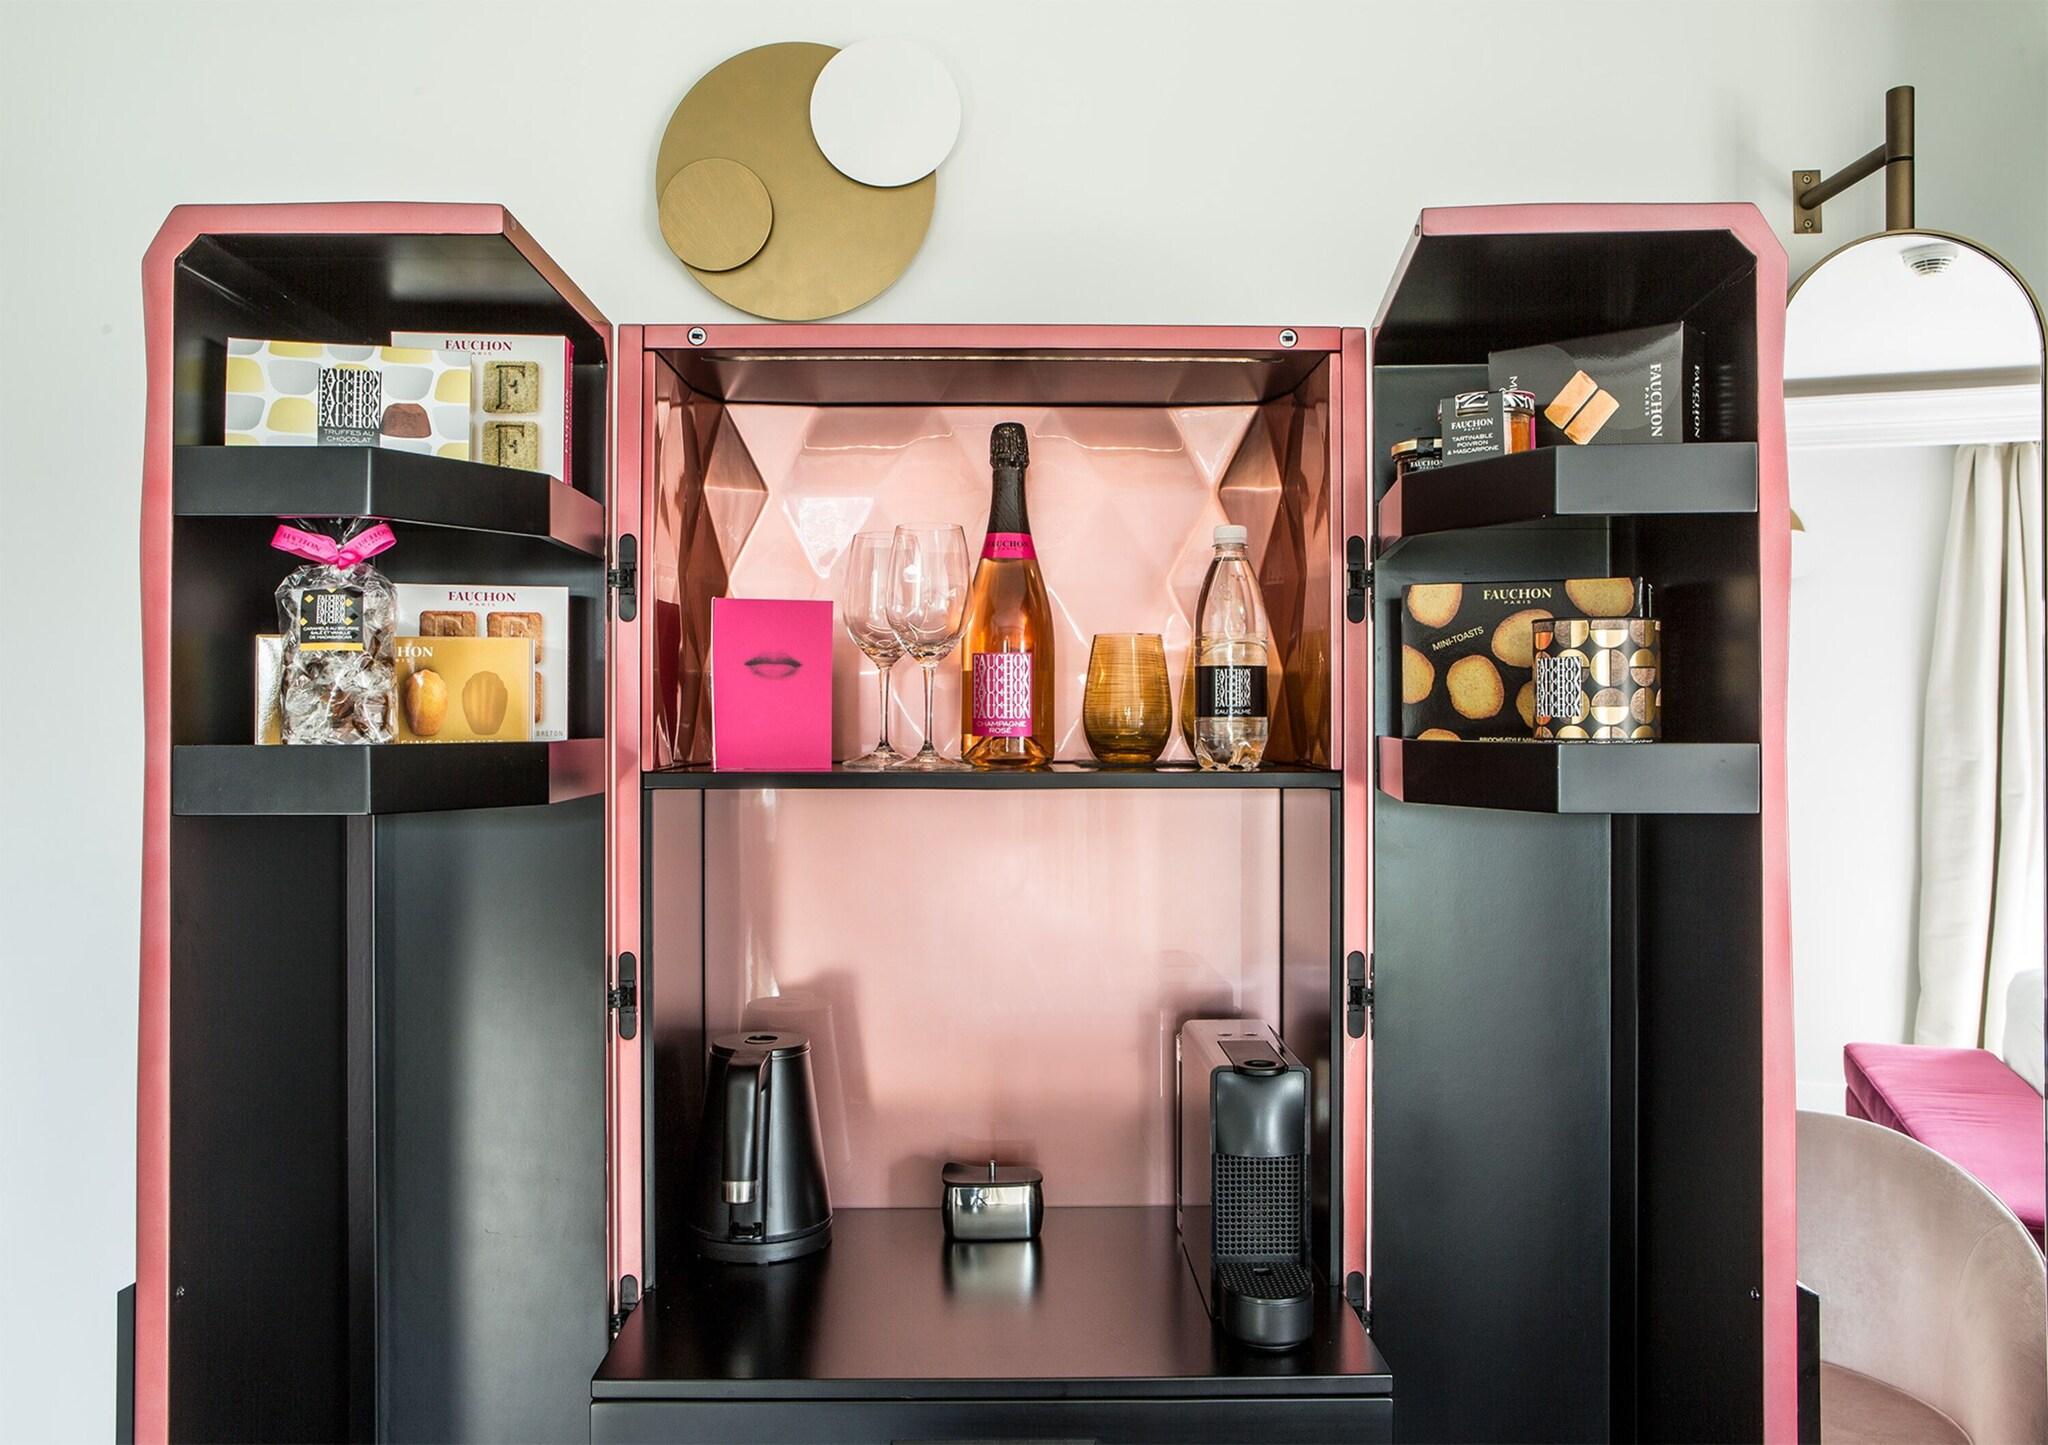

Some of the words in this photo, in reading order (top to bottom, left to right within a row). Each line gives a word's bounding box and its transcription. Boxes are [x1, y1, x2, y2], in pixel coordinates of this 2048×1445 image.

[445, 340, 513, 350] FAUCHON
[319, 368, 382, 382] FAUCHON
[1650, 363, 1663, 437] FAUCHON
[318, 414, 380, 429] FAUCHON
[1451, 418, 1494, 430] FAUCHON
[1452, 432, 1493, 442] TARTINABLE
[1453, 445, 1499, 454] MASCARPONE
[1456, 440, 1488, 448] POIVRON
[448, 592, 516, 602] FAUCHON
[1483, 588, 1552, 600] FAUCHON
[1432, 626, 1485, 651] MINI-TOASTS
[973, 654, 1032, 668] FAUCHON
[973, 704, 1031, 719] FAUCHON
